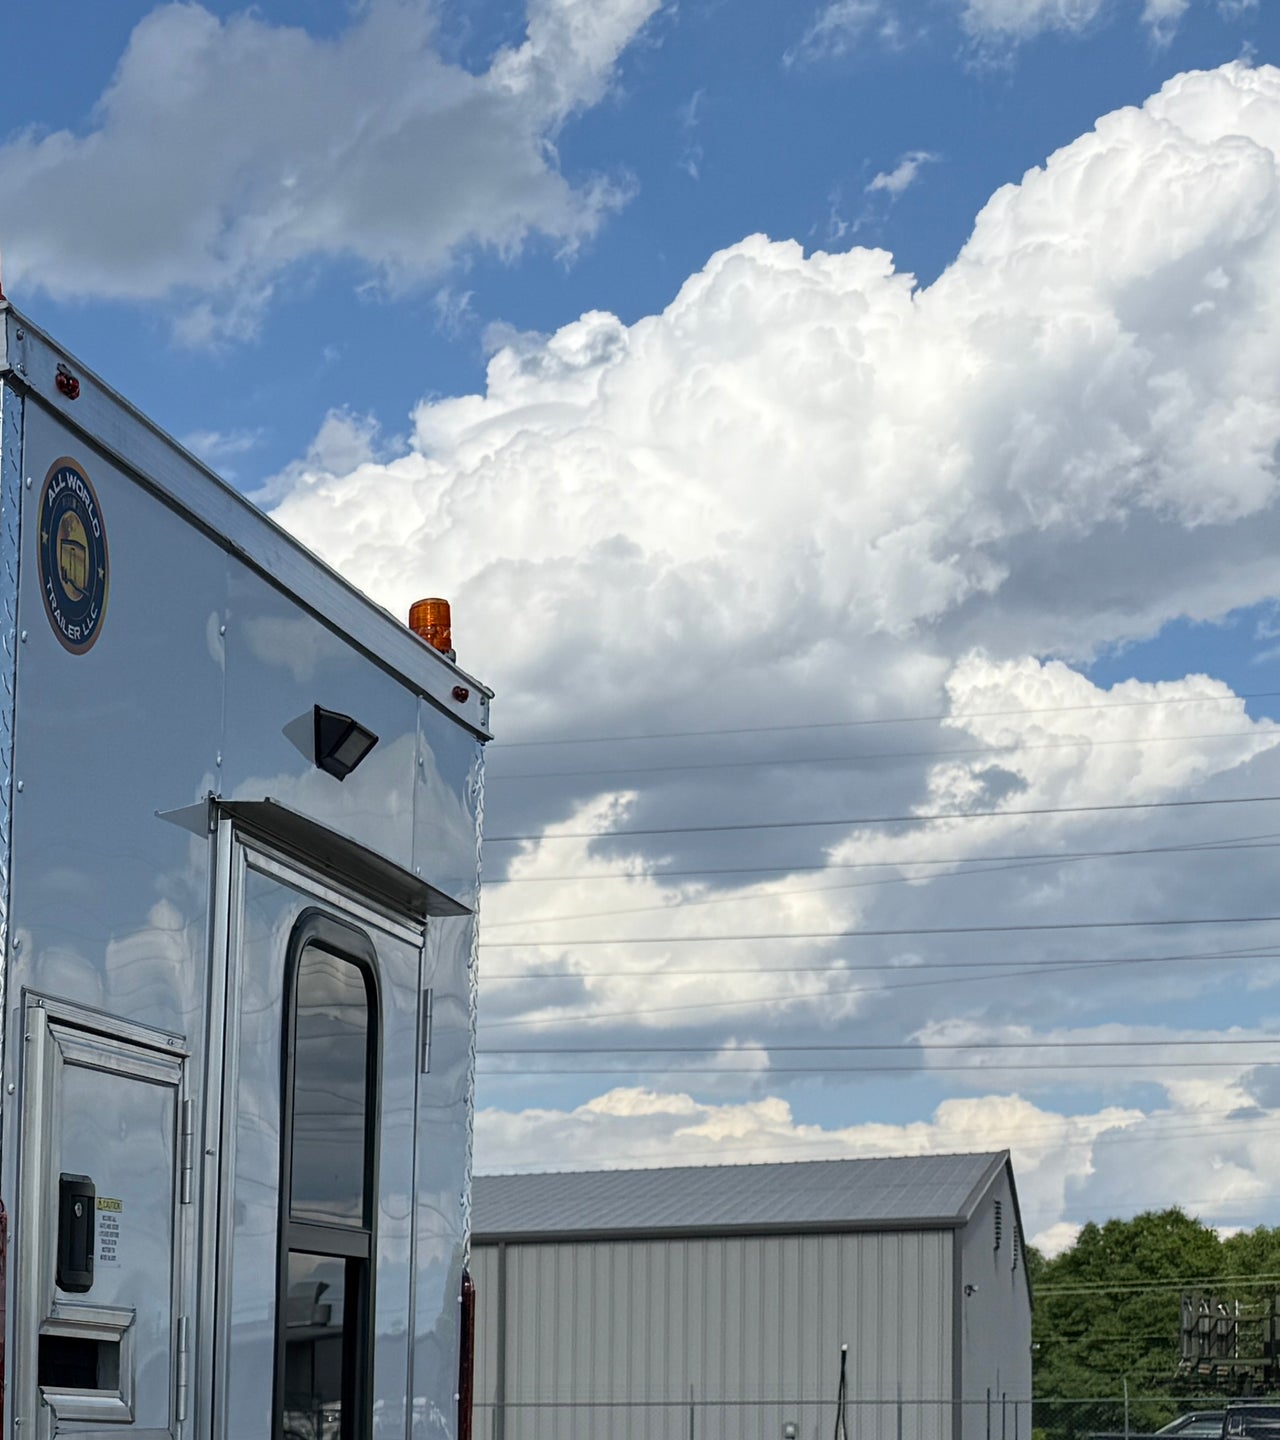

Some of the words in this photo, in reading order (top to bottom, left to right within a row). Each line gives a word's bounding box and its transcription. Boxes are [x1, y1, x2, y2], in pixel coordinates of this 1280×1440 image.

[47, 473, 66, 507] ALL
[66, 471, 100, 539] WORLD
[46, 576, 81, 641] TRAILER
[82, 602, 98, 636] LLC
